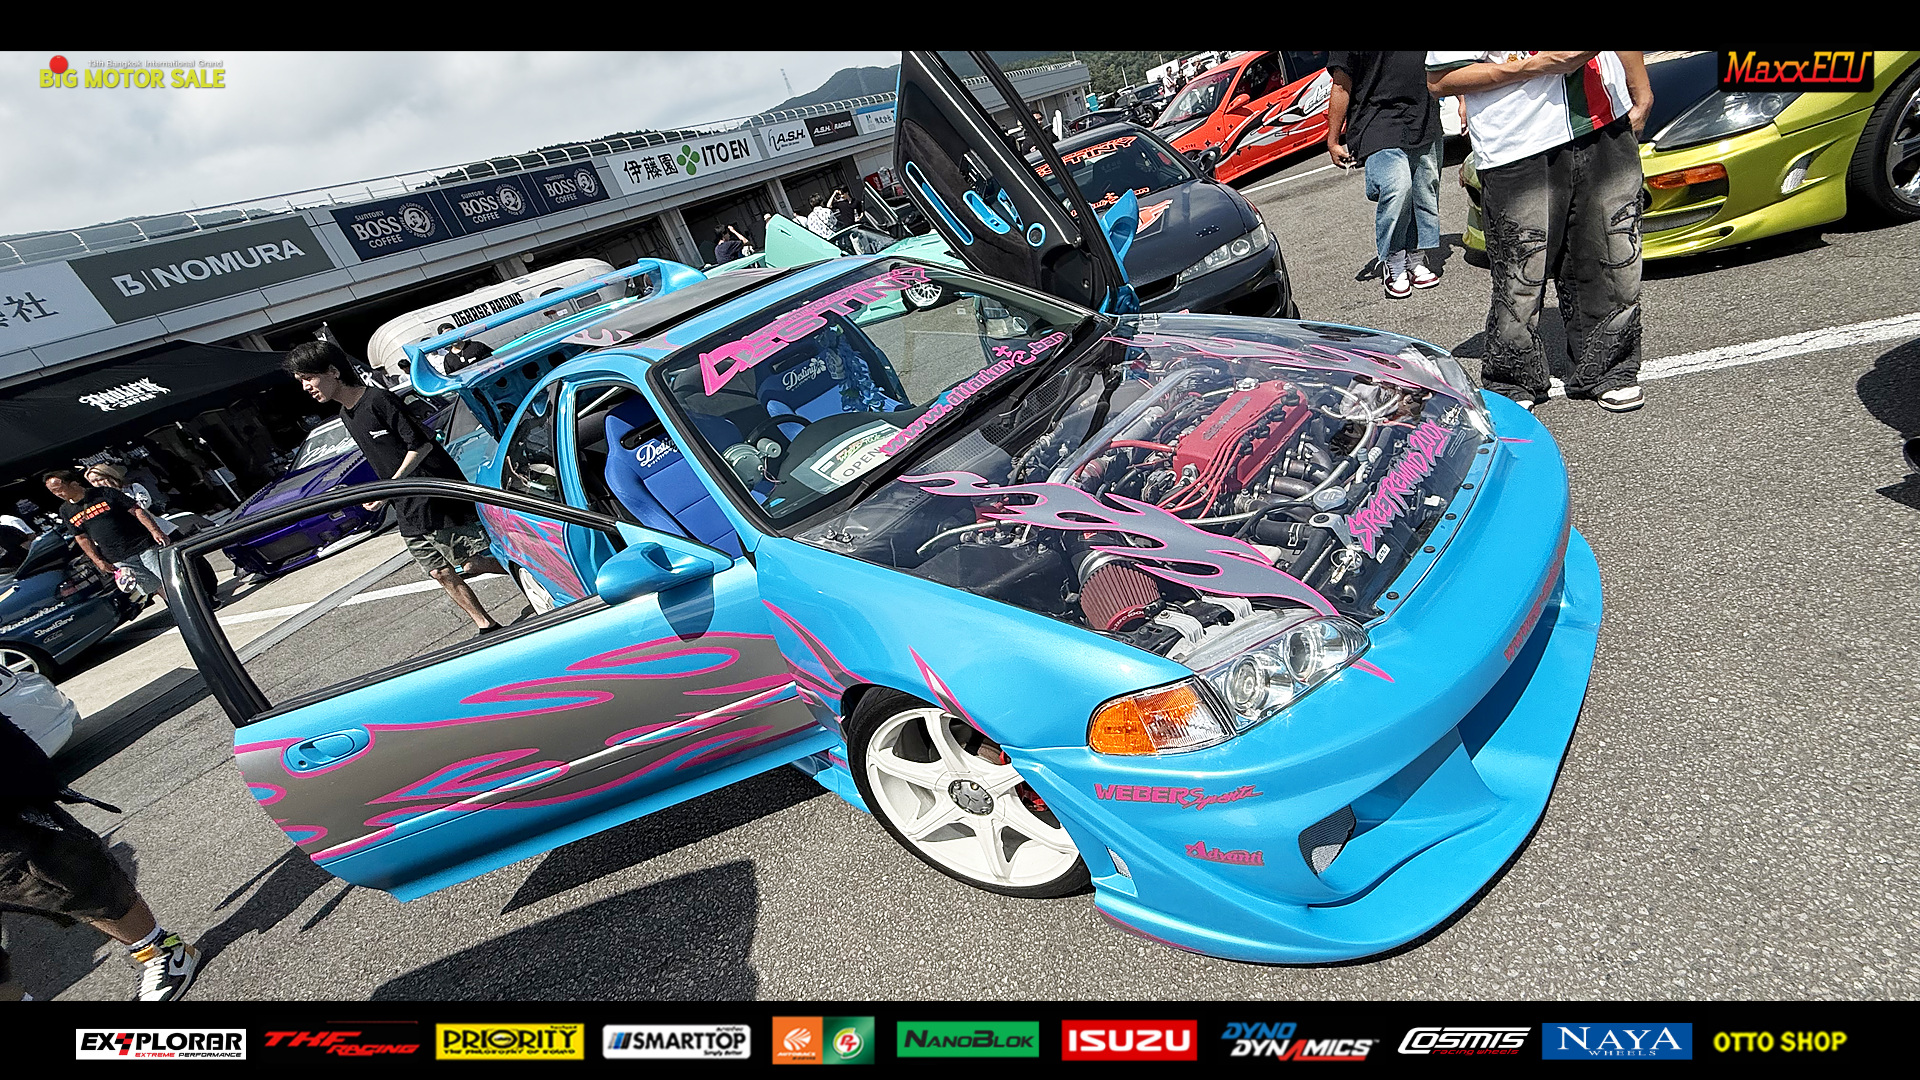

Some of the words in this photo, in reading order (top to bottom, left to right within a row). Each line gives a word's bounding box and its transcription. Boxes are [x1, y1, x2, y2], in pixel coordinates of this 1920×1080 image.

[623, 153, 679, 185] 伊藤園
[543, 178, 577, 198] BOSS
[555, 193, 578, 204] COFFEE
[354, 210, 385, 221] SUNTORY
[458, 195, 499, 217] BOSS
[472, 211, 500, 224] COFFEE
[350, 216, 402, 241] BOSS
[368, 233, 403, 249] COFFEE
[151, 239, 306, 288] NOMURA
[489, 291, 525, 315] RACING
[699, 267, 932, 396] DESTINY
[782, 365, 819, 392] Destiny
[1094, 783, 1191, 806] WEBER
[1185, 841, 1265, 866] Advanti
